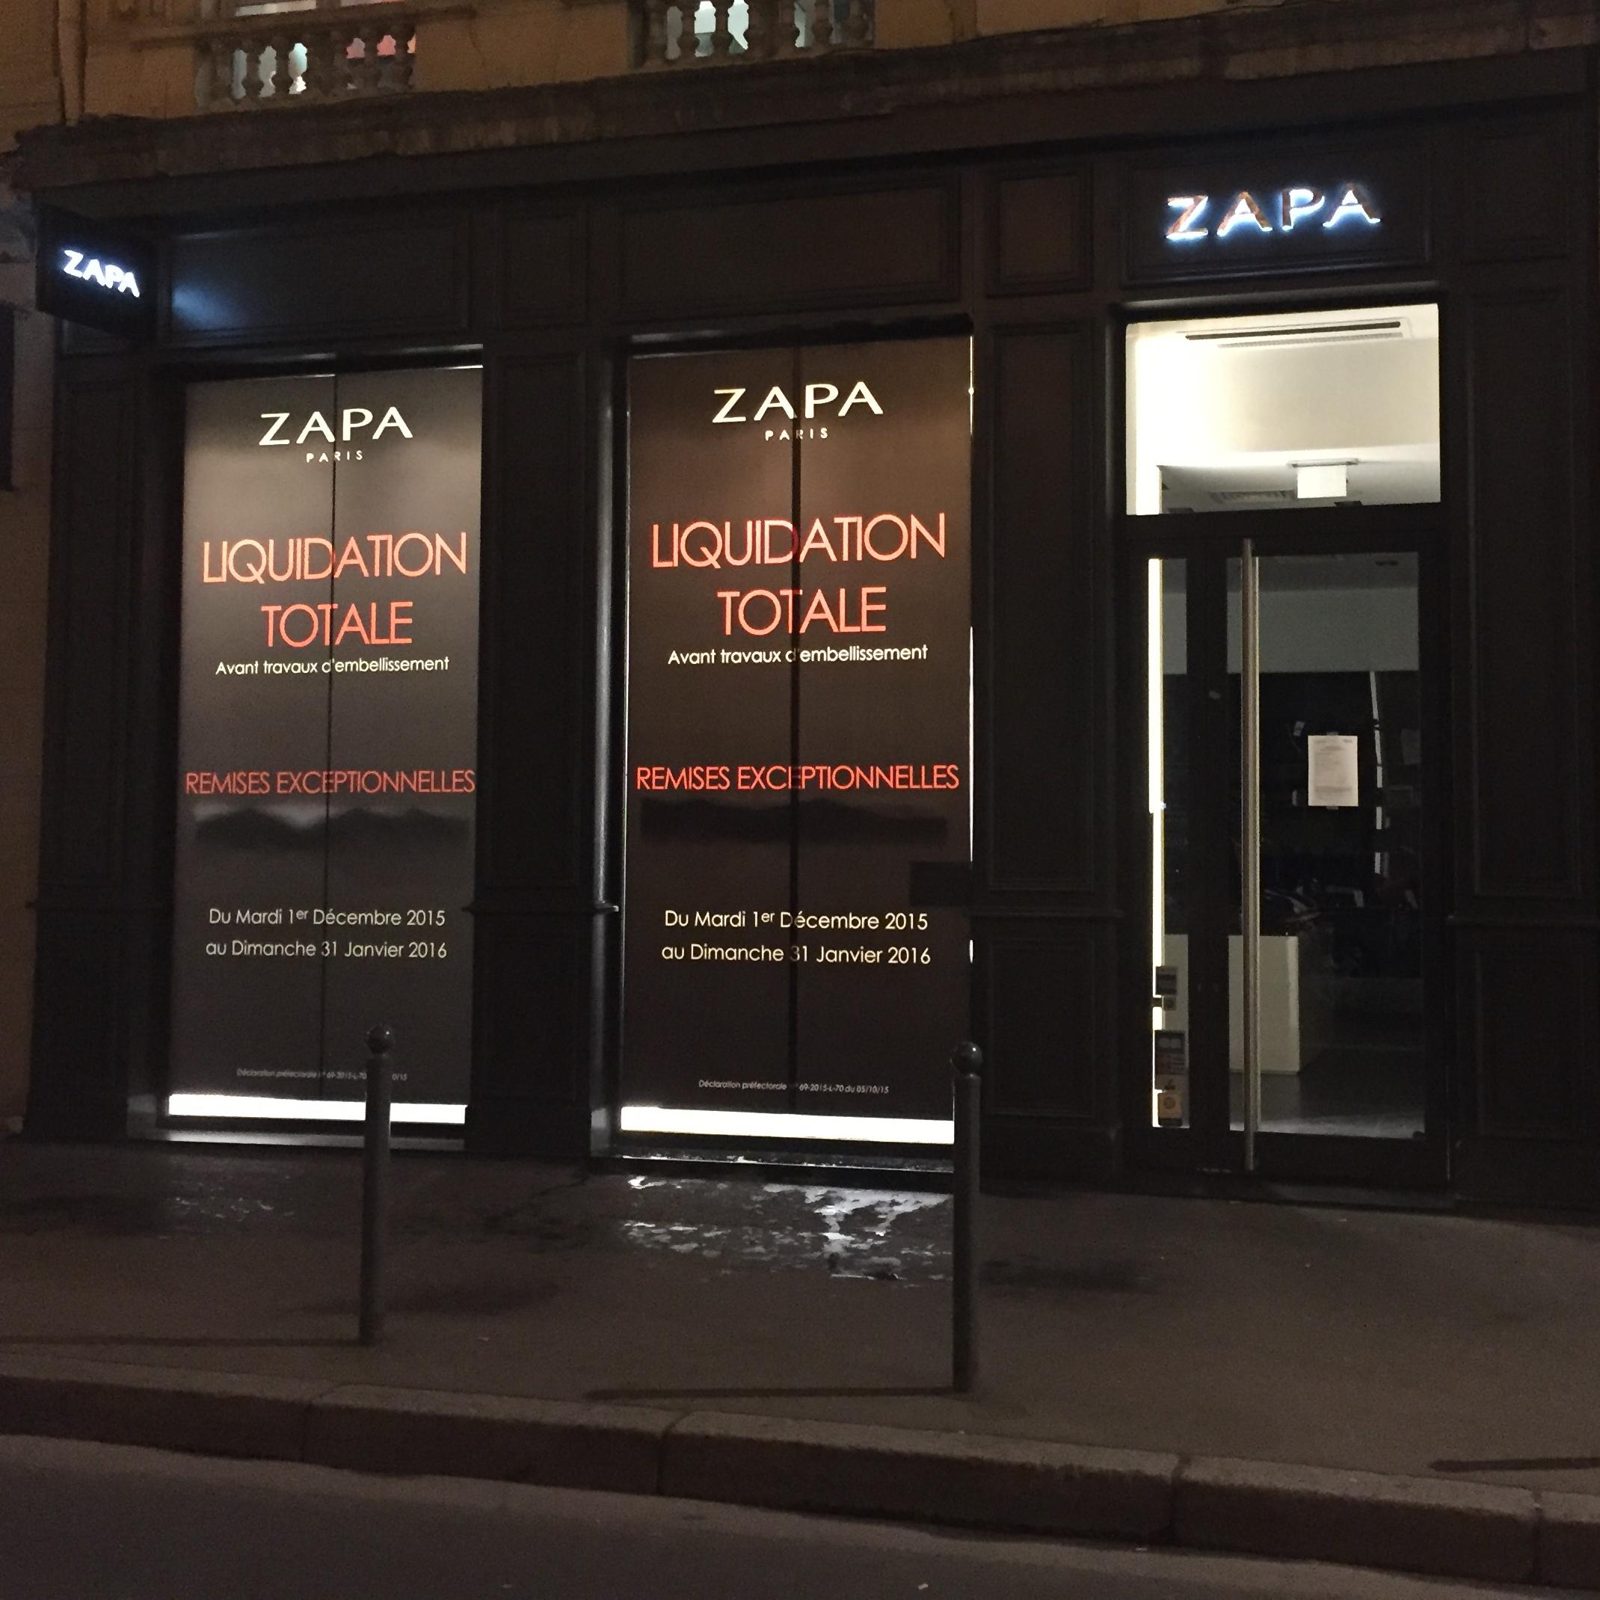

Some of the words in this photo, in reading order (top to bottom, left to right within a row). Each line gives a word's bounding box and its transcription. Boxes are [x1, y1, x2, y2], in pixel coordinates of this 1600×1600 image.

[1165, 181, 1381, 240] ZAPA
[63, 249, 141, 298] ZAPA
[711, 381, 884, 424] ZAPA
[258, 406, 414, 446] ZAPA
[764, 427, 829, 442] PARIS
[305, 449, 363, 464] PARIS
[652, 512, 946, 569] LIQUIDATION
[202, 531, 467, 585] LIQUIDATION
[260, 600, 414, 648] TOTALE
[716, 586, 887, 636] TOTALE
[215, 660, 259, 676] Avant
[262, 660, 318, 675] travaux
[322, 656, 450, 674] d'embellissement
[667, 648, 717, 665] Avant
[719, 648, 782, 664] travaux
[185, 771, 271, 795] REMISES
[276, 769, 476, 794] EXCEPTIONNELLES
[636, 765, 731, 791] REMISES
[737, 764, 960, 791] EXCEPTIONNELLES
[209, 907, 232, 924] Du
[235, 908, 283, 925] Mardi
[288, 908, 309, 925] 1er
[313, 908, 402, 926] Décembre
[406, 909, 446, 927] 2015
[664, 909, 689, 927] Du
[694, 910, 746, 928] Mardi
[753, 911, 776, 928] 1er
[780, 910, 880, 930] Décembre
[884, 912, 928, 931] 2015
[205, 942, 227, 956] au
[231, 939, 317, 957] Dimanche
[321, 940, 337, 957] 31
[344, 941, 405, 958] Janvier
[408, 941, 447, 959] 2016
[661, 946, 685, 960] au
[690, 943, 785, 962] Dimanche
[789, 944, 809, 962] 31
[816, 945, 884, 964] Janvier
[887, 946, 931, 965] 2016
